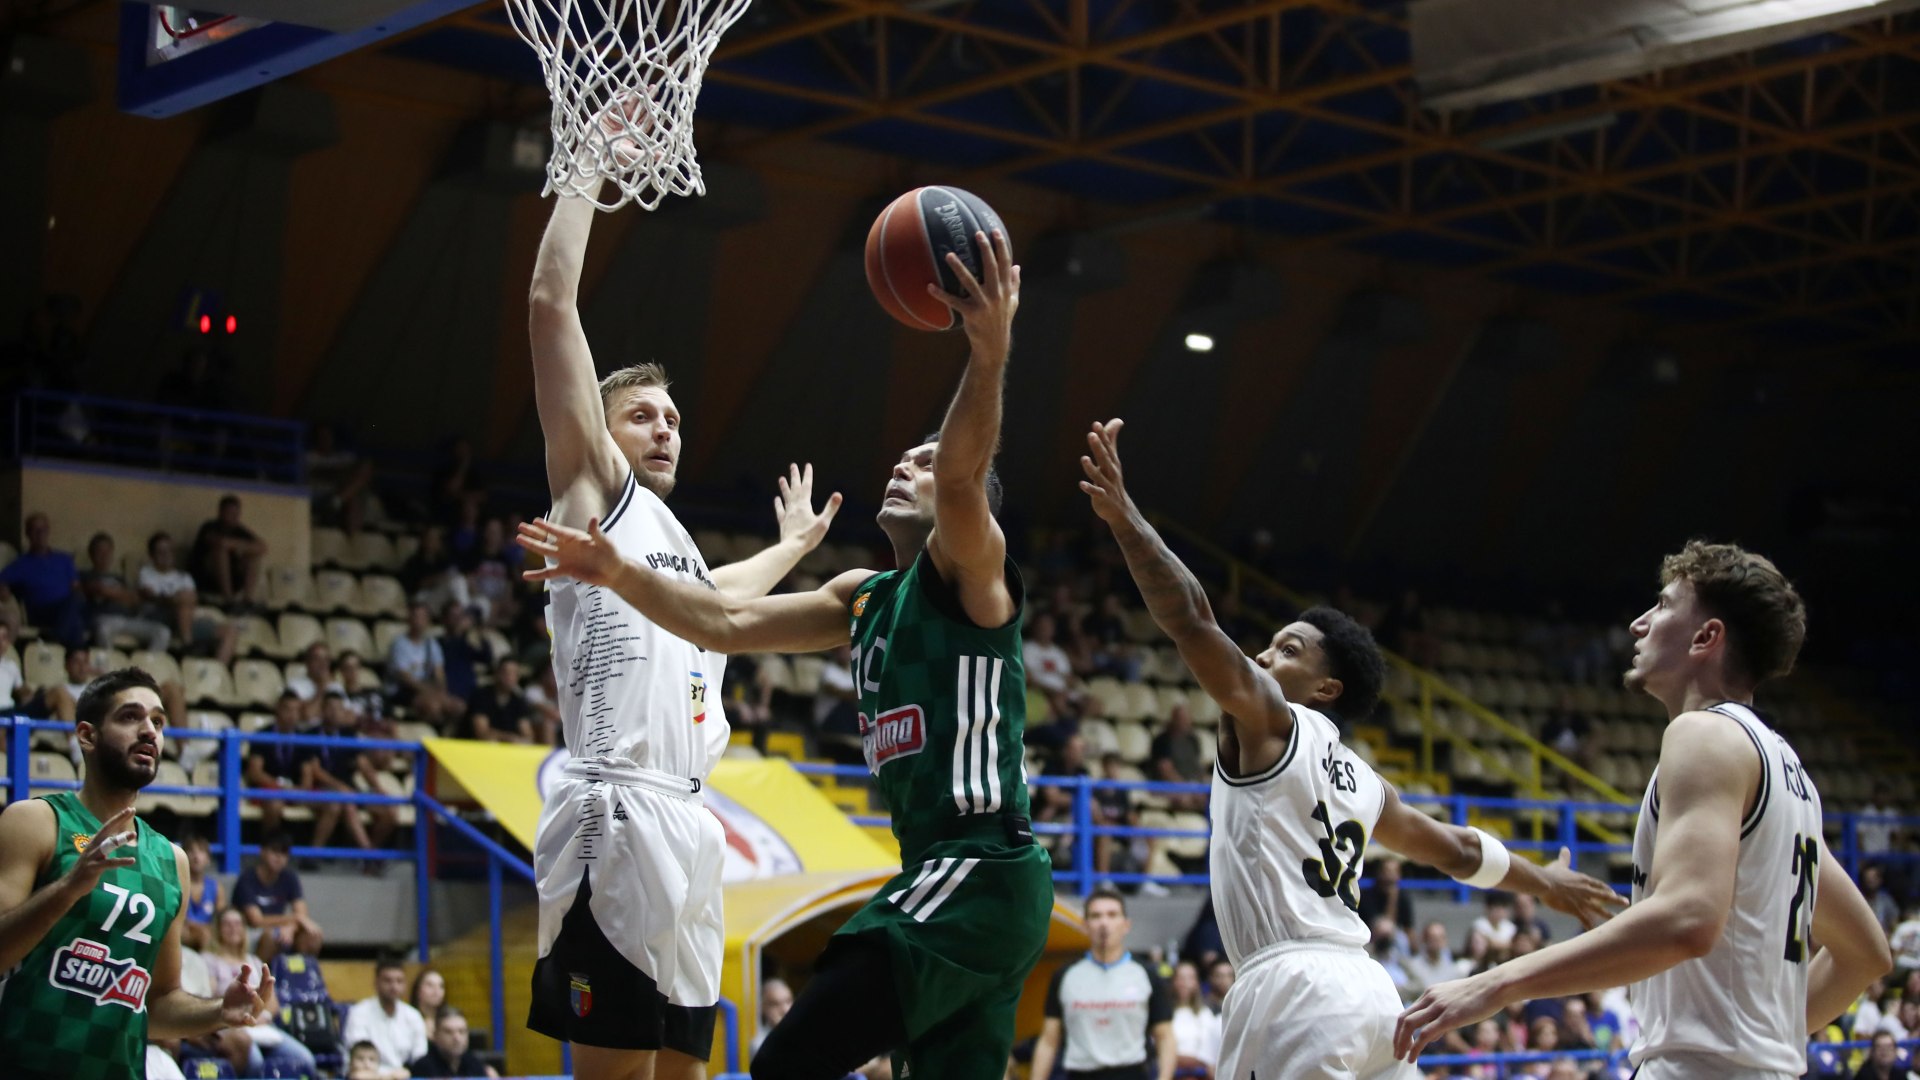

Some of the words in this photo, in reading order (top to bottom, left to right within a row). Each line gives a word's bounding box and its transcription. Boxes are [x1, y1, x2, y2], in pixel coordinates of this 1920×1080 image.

[1322, 742, 1357, 793] JES
[1302, 800, 1367, 912] 32
[101, 882, 155, 944] 72
[74, 943, 105, 960] pame
